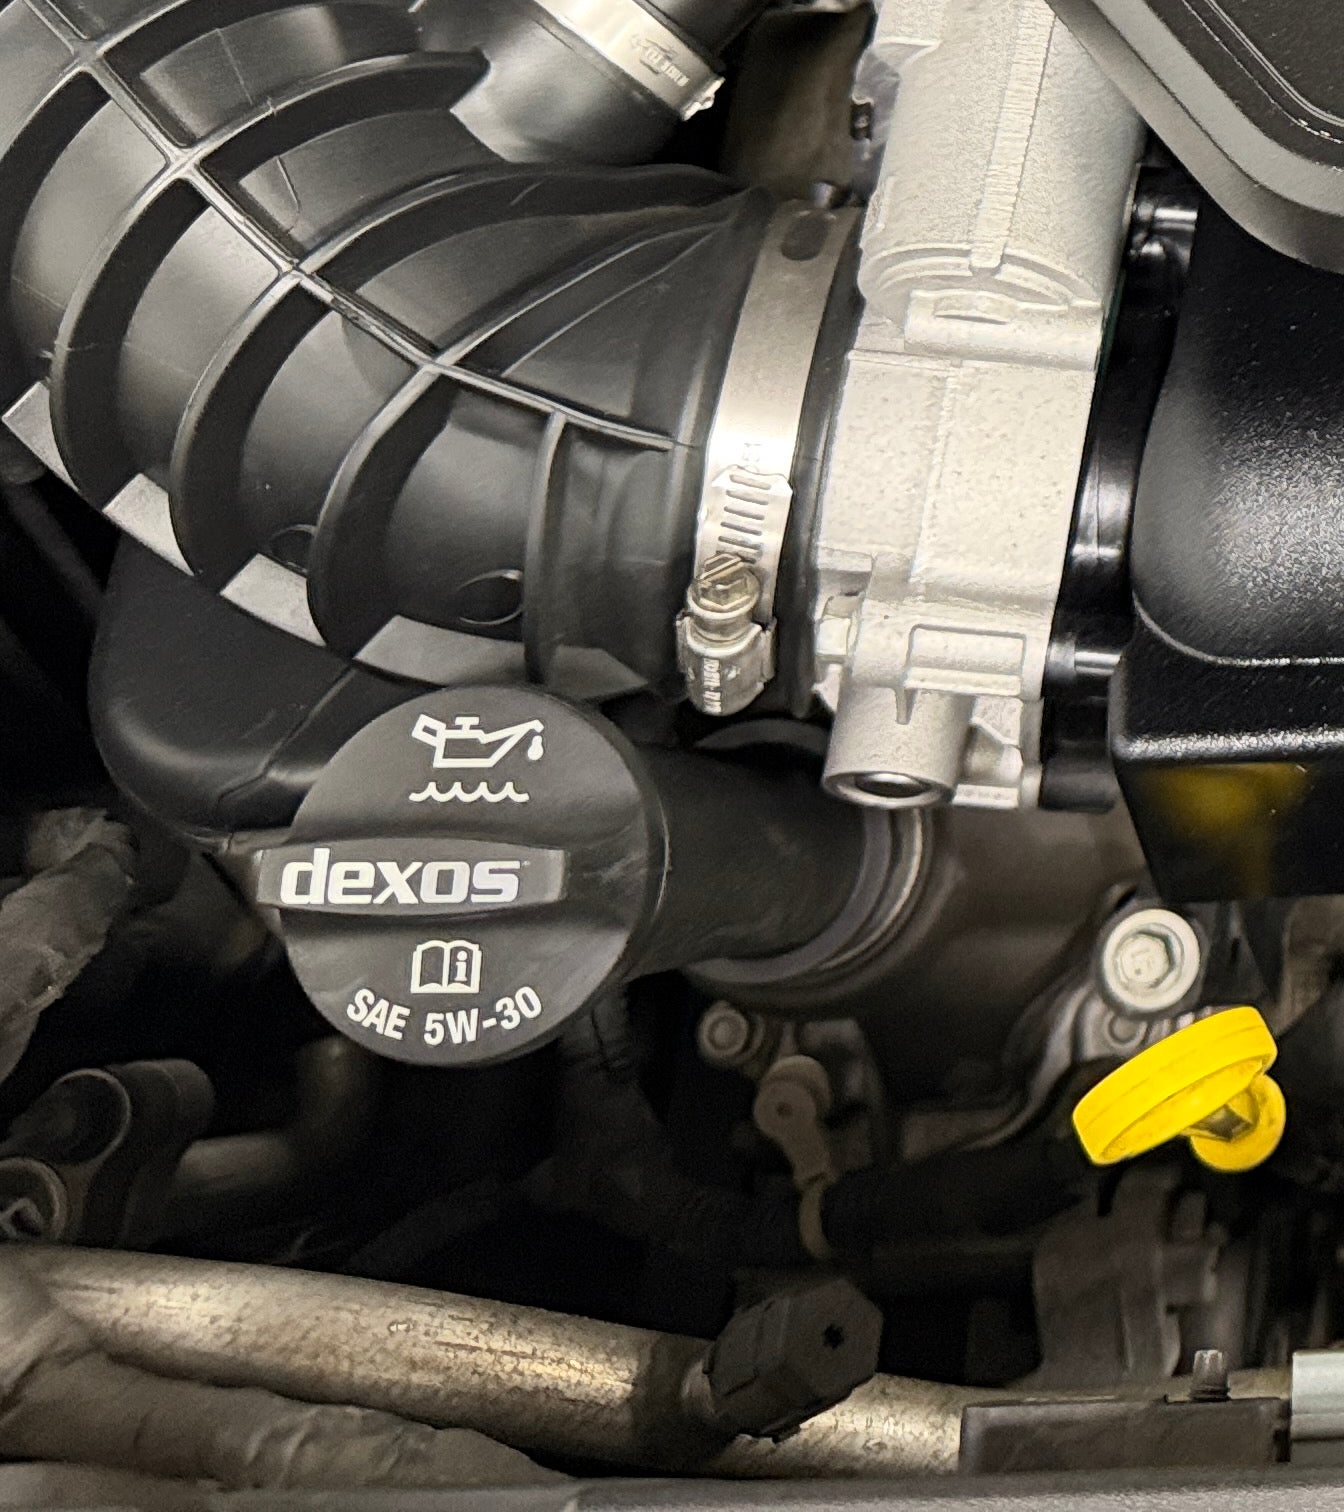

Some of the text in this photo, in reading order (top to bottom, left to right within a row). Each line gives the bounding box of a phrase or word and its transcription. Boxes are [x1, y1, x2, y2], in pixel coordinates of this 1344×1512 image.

[279, 847, 522, 905] dexos
[346, 986, 543, 1046] SAE 5W-30
